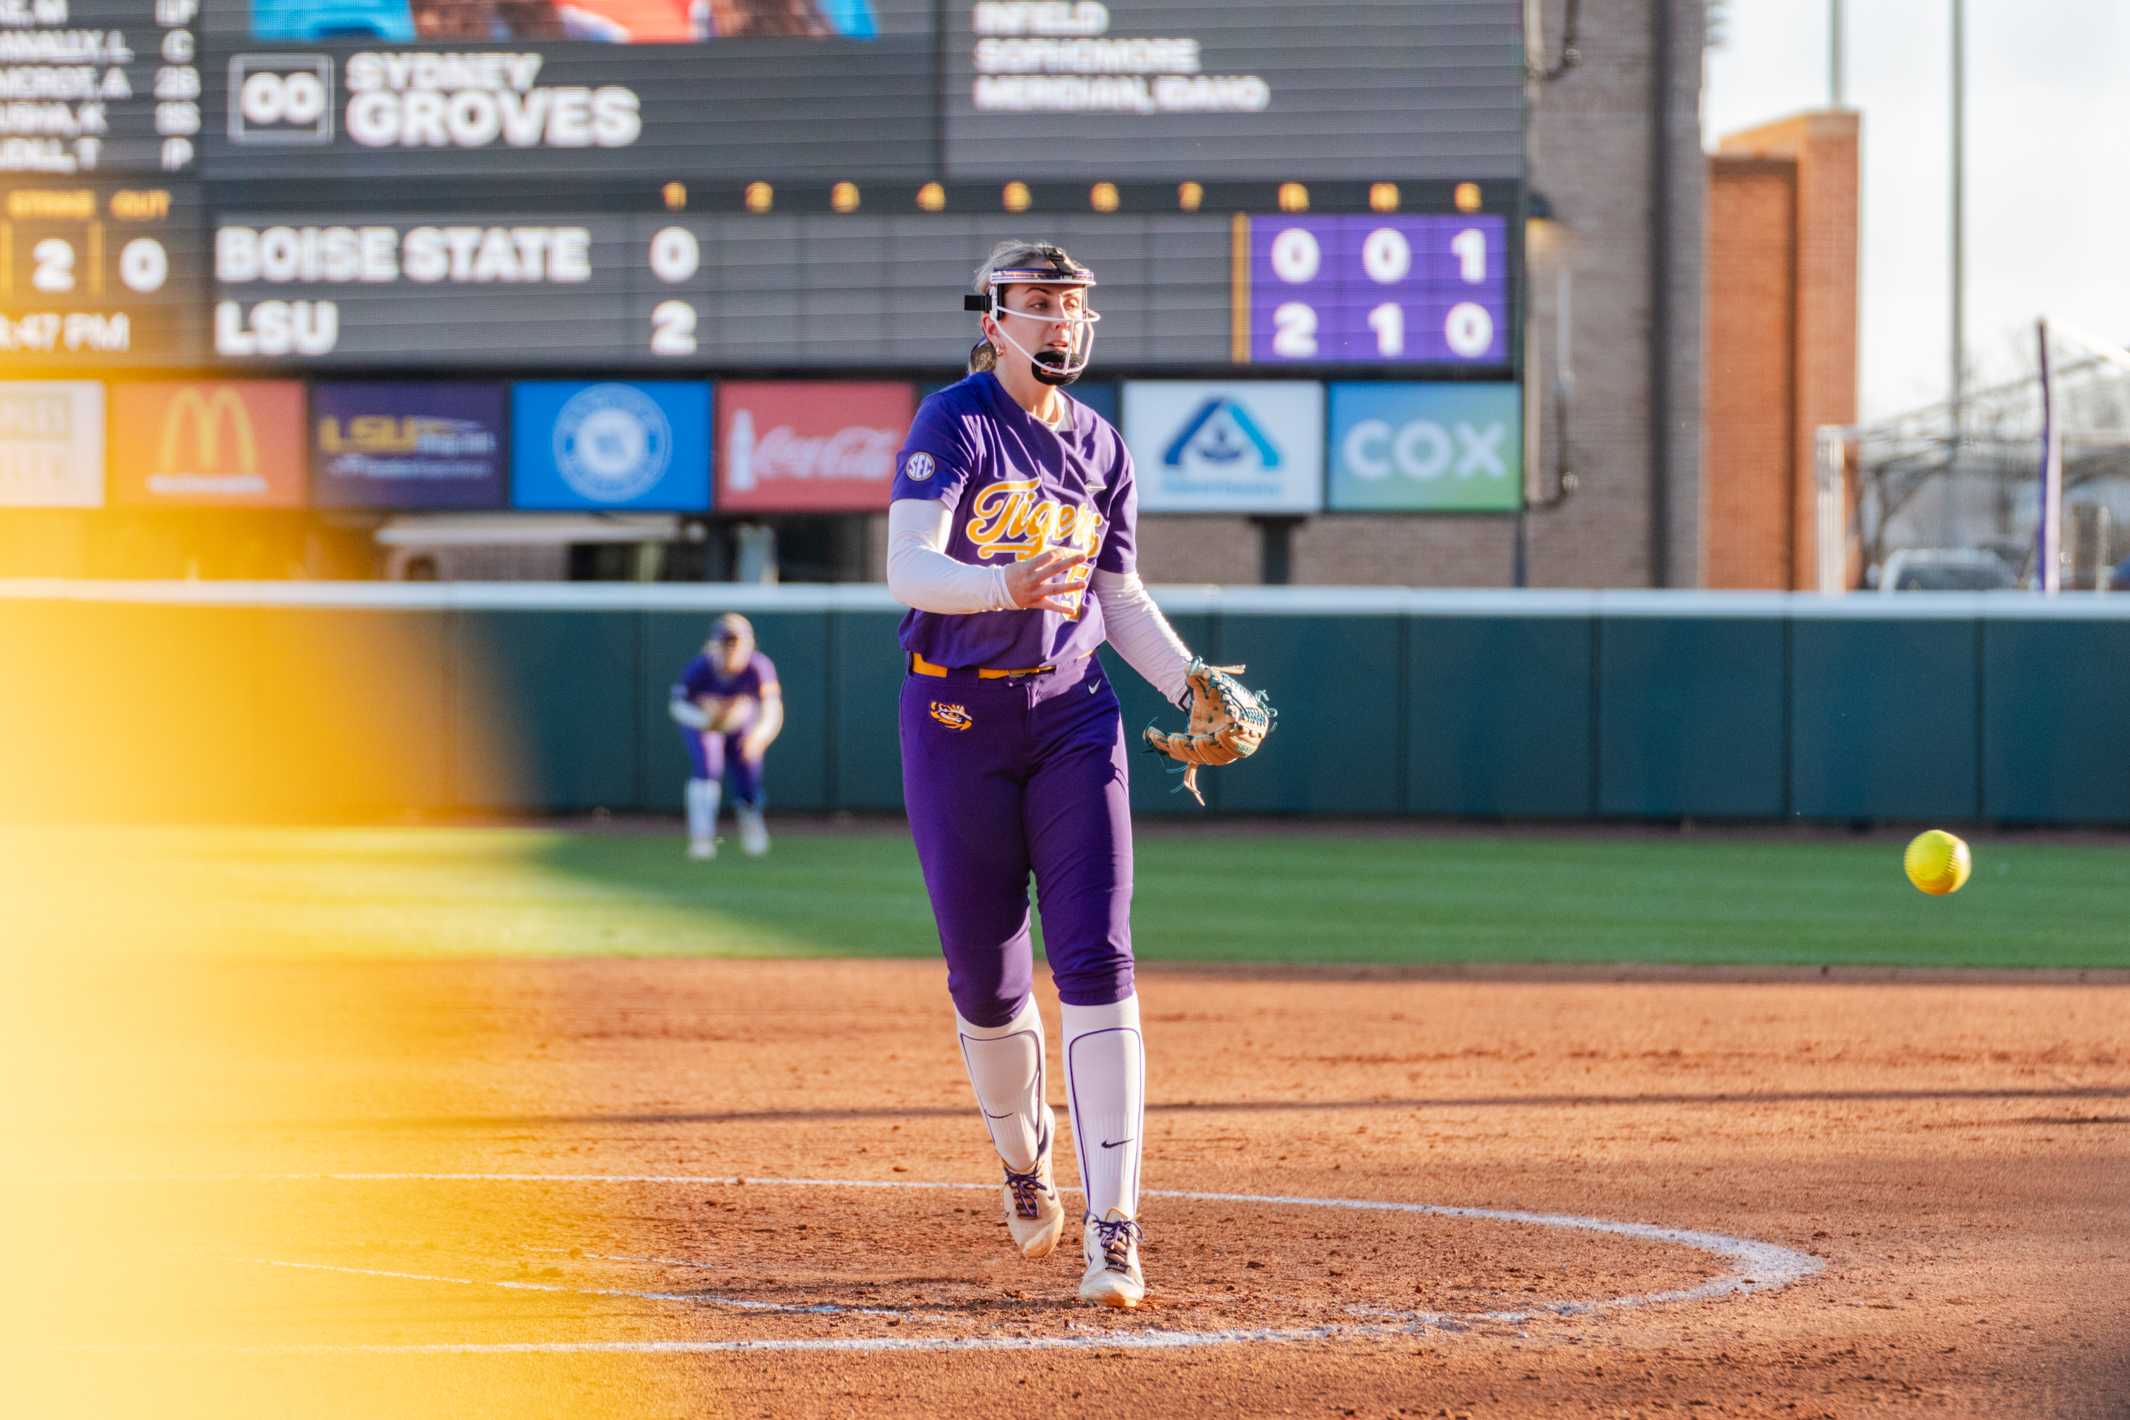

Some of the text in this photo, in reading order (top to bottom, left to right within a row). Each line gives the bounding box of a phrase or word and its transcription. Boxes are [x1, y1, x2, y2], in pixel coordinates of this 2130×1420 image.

[345, 53, 543, 92] SYDNEY
[974, 38, 1201, 74] SOPHOMORE
[241, 72, 326, 124] 00
[345, 86, 642, 147] GROVES
[110, 189, 173, 221] OUT
[33, 237, 169, 294] 2 0
[215, 225, 1487, 284] BOISE STATE 0 0 0 1
[0, 312, 130, 351] :47 PM
[215, 299, 1495, 358] LSU 2 2 1 0
[318, 415, 418, 454] LSU
[1342, 418, 1508, 480] COX
[907, 453, 933, 479] SEC
[966, 478, 1104, 561] Tigers
